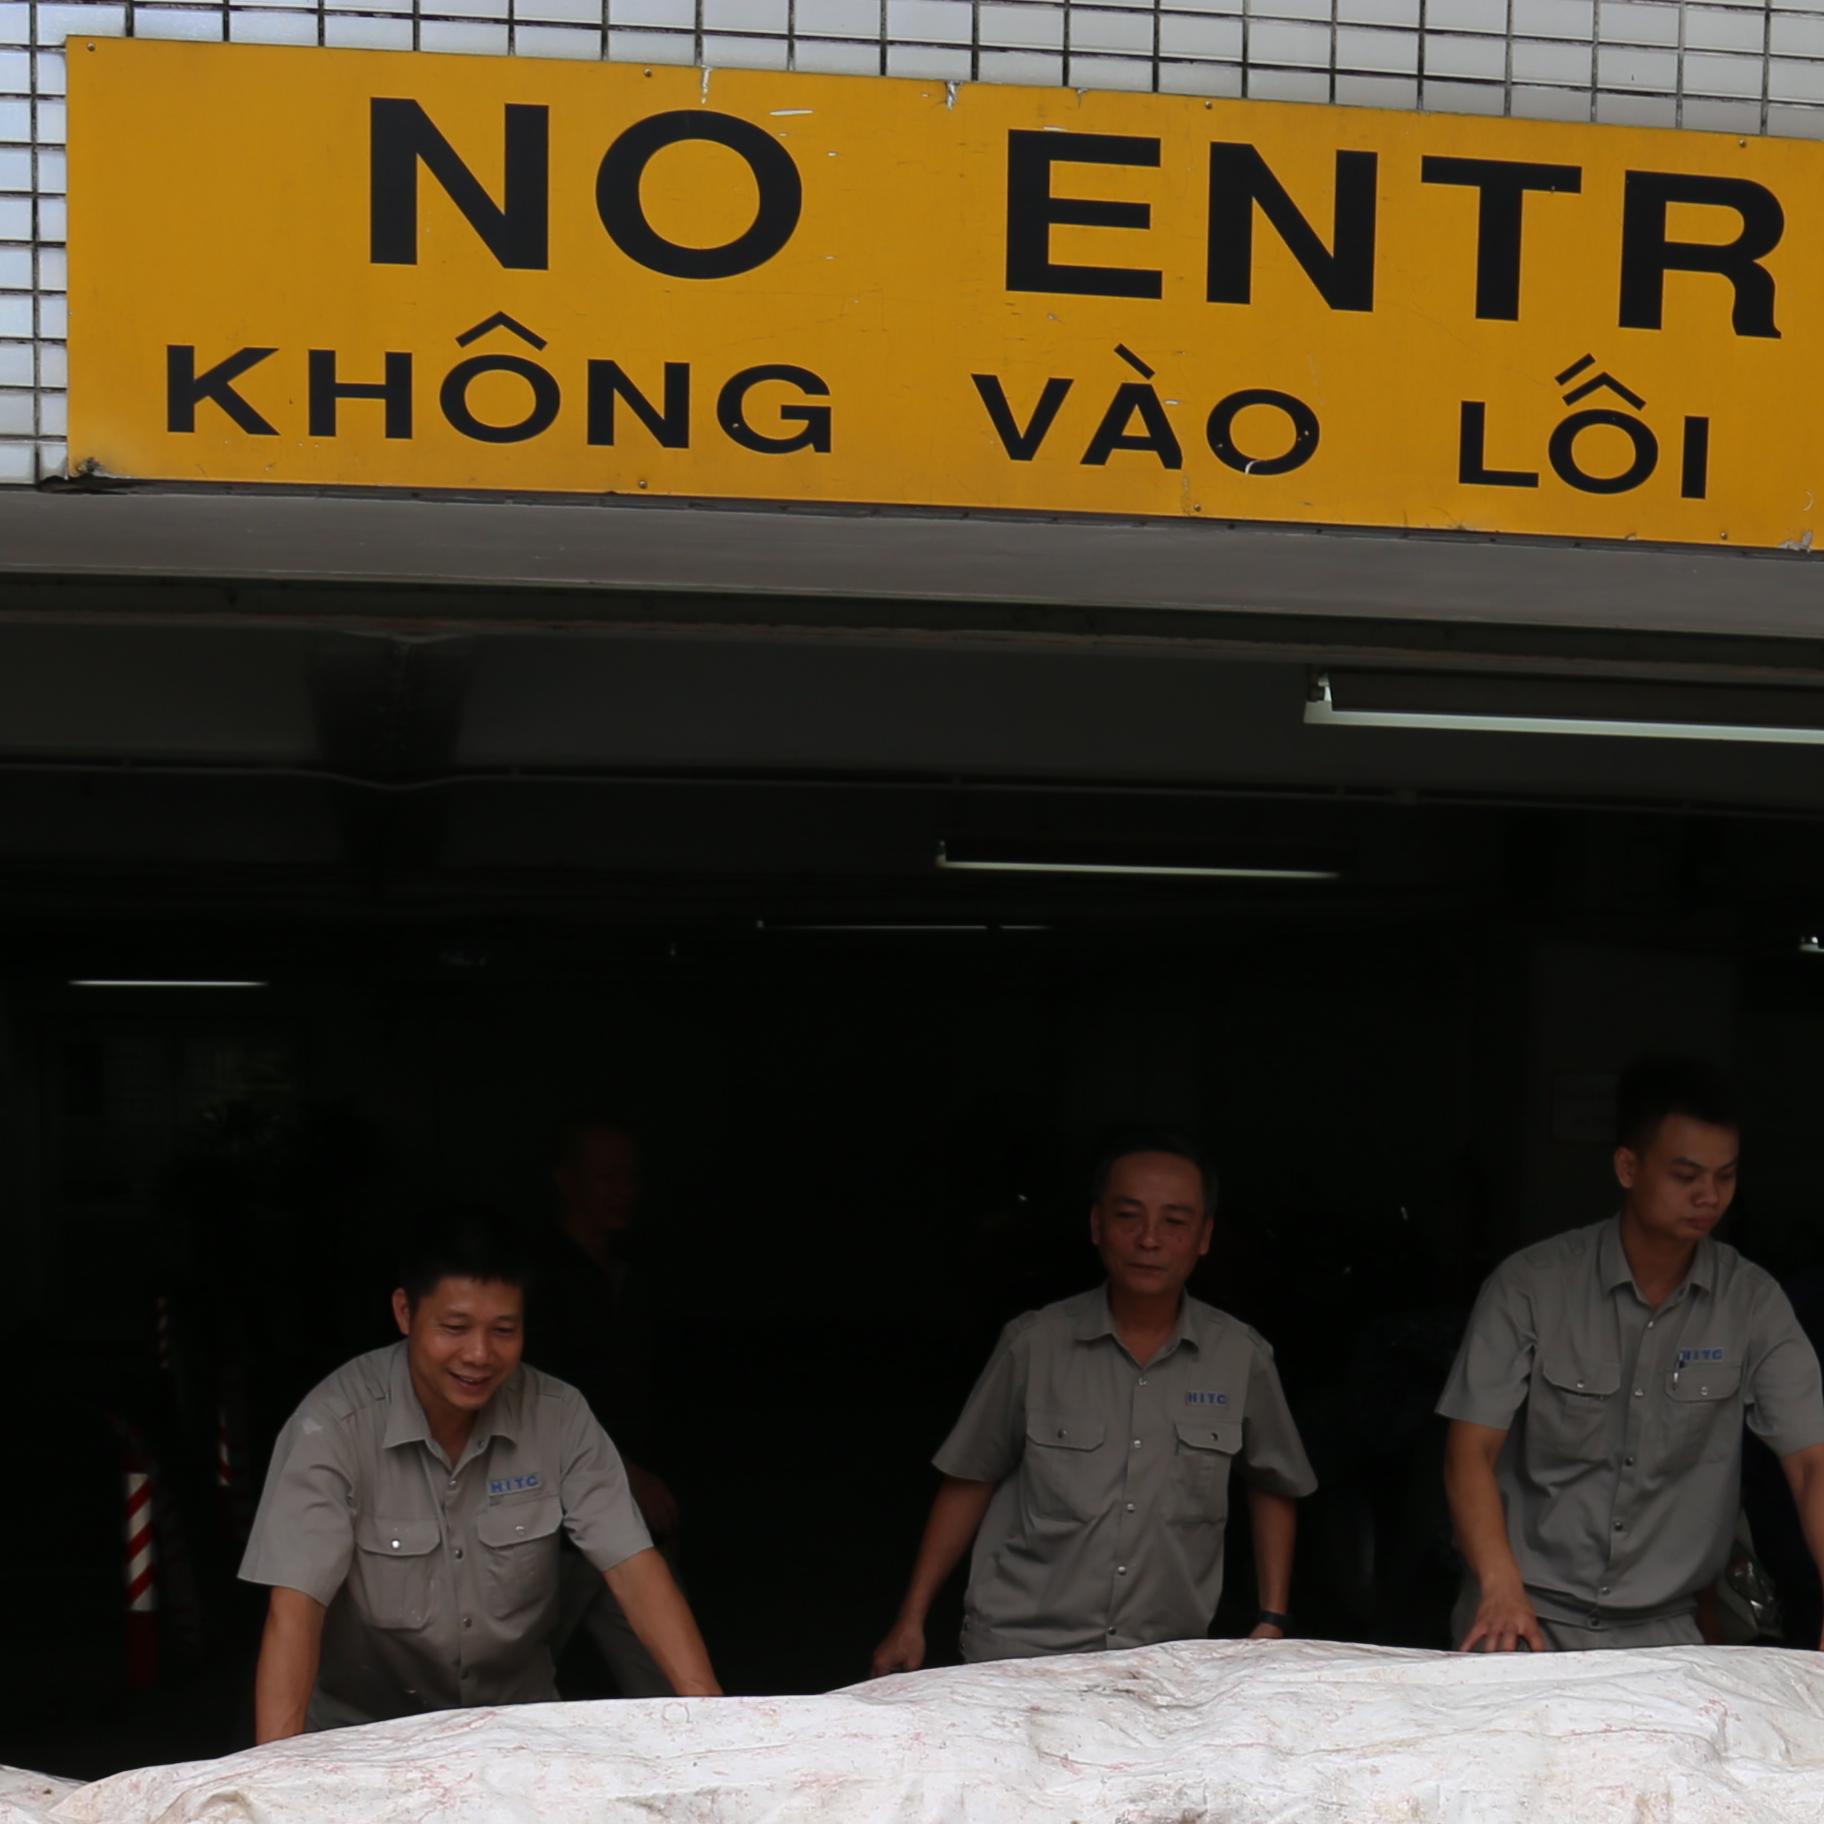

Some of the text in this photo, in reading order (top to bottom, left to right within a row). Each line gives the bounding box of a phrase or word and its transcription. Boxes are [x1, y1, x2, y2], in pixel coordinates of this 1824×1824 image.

[371, 98, 801, 279] NO
[168, 312, 832, 454] KHÔNG
[971, 342, 1320, 476] VÀO
[1459, 353, 1709, 499] LỐI
